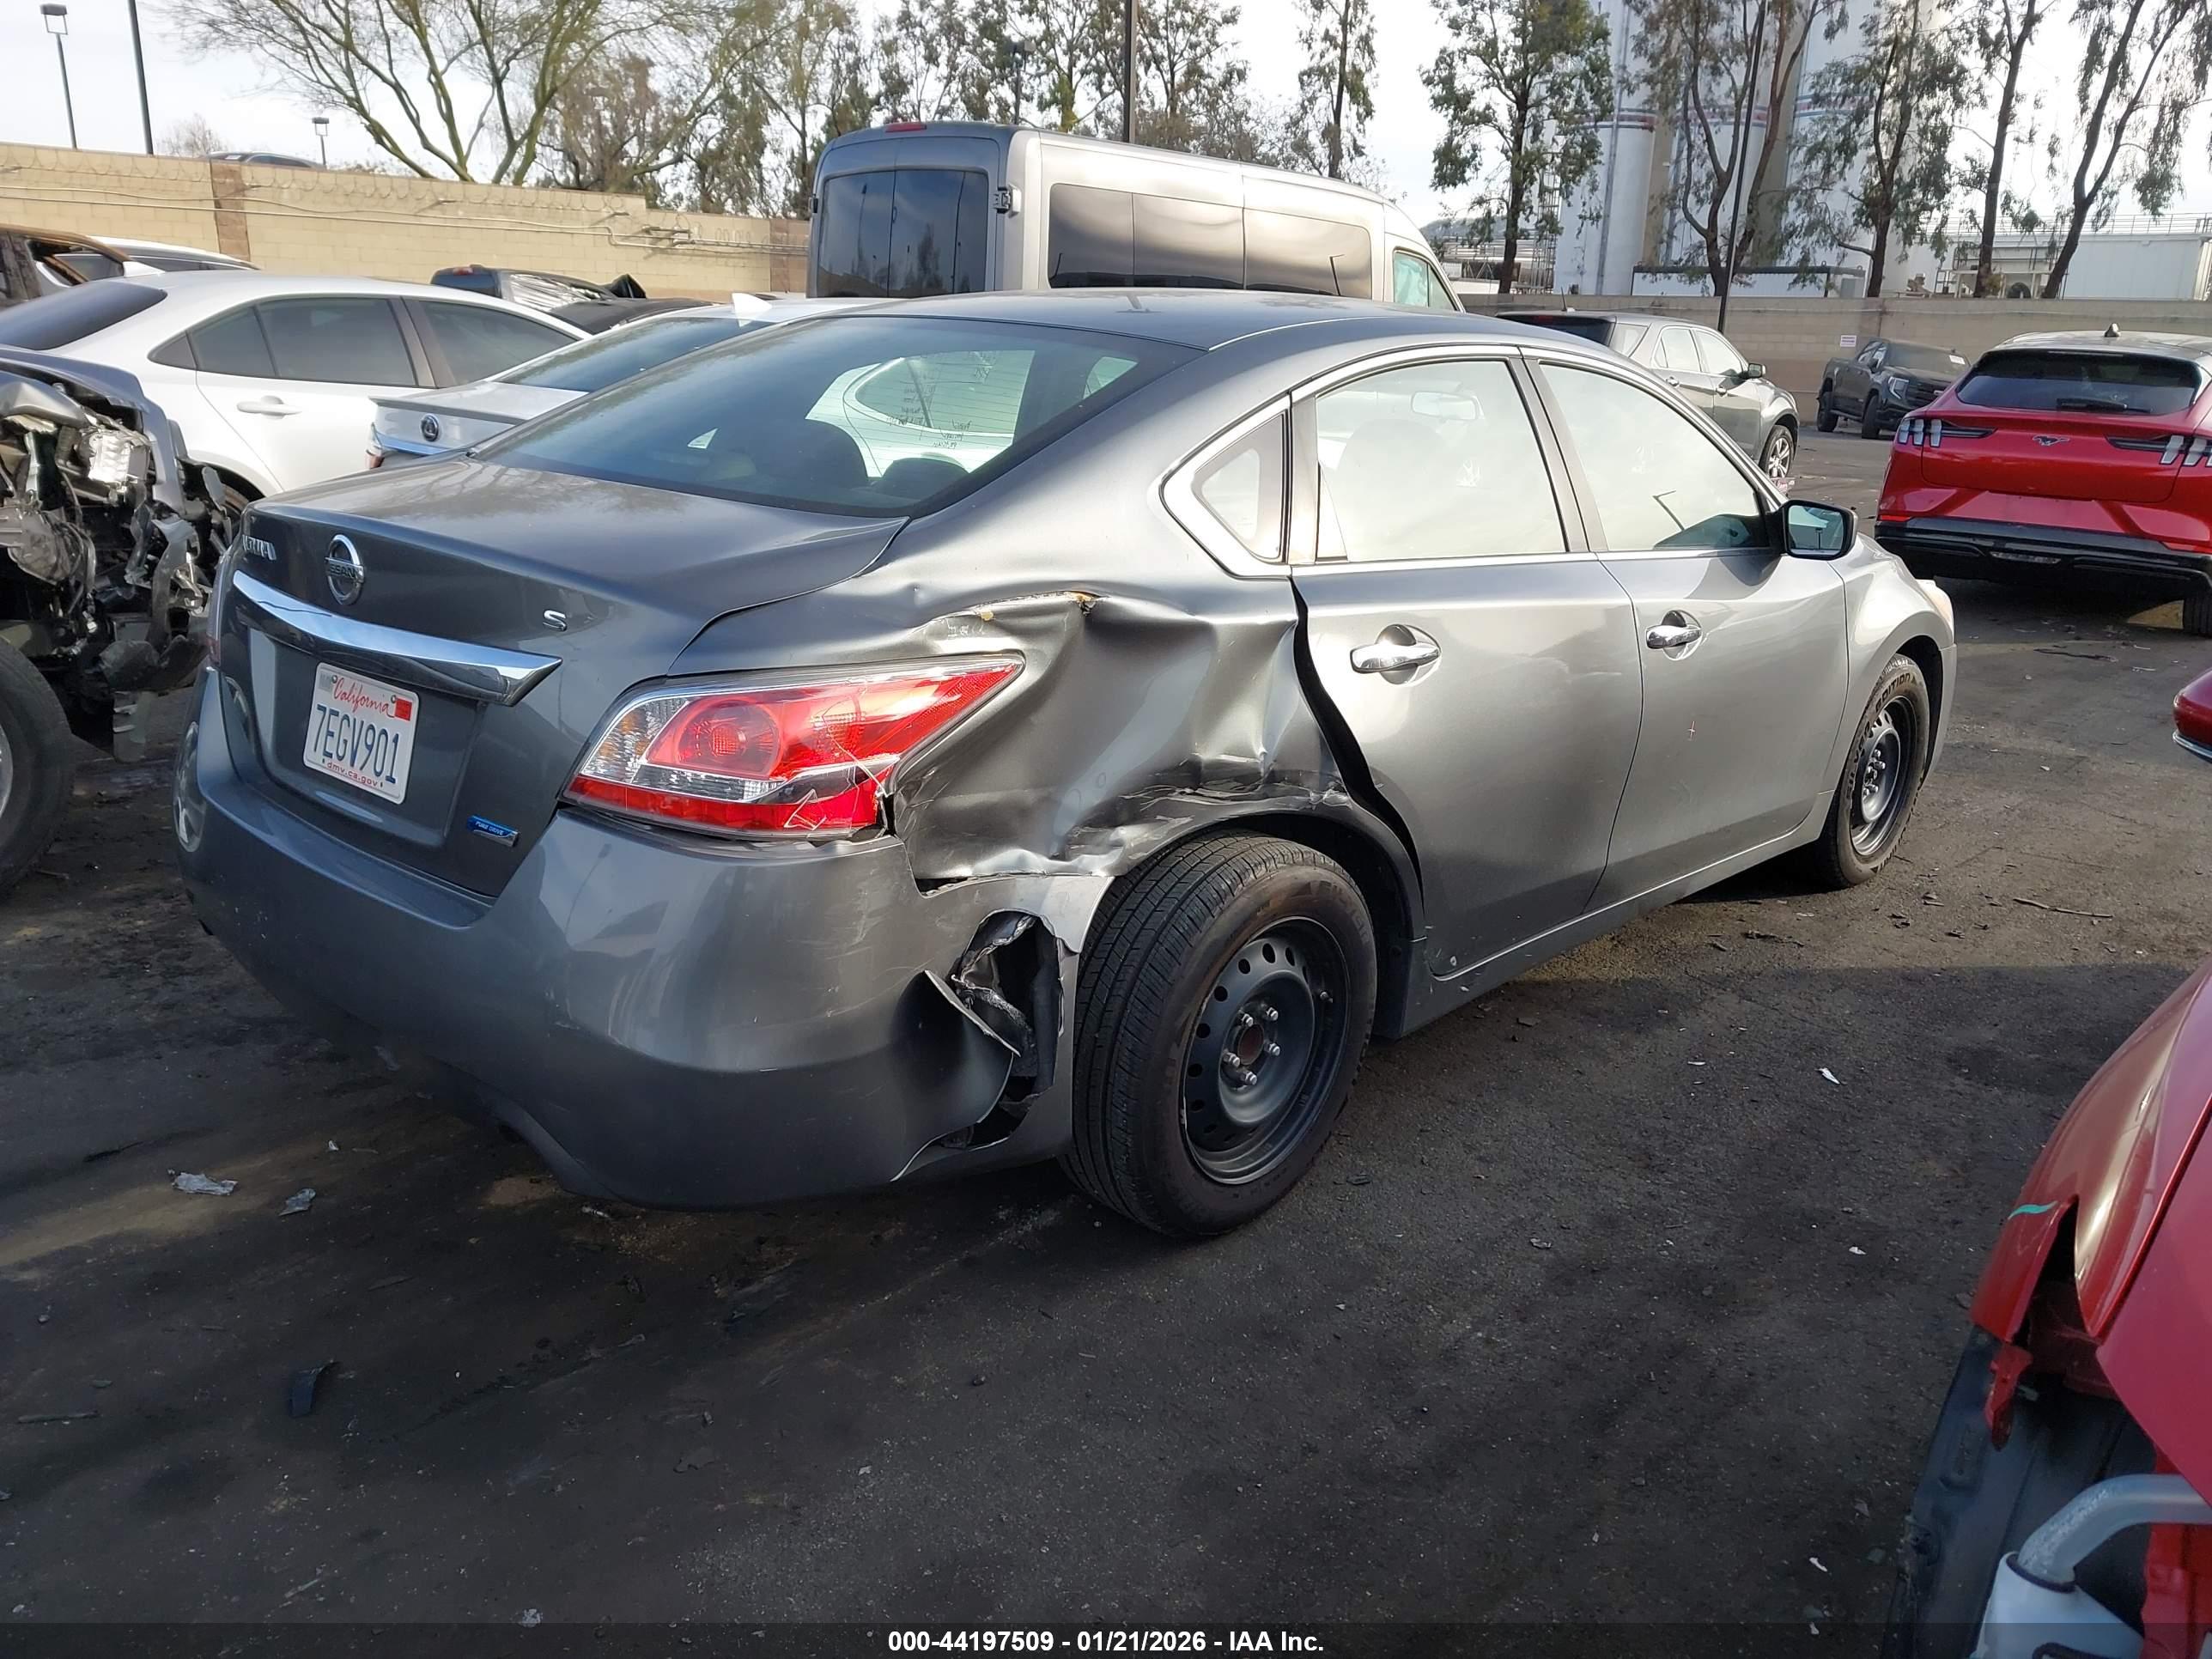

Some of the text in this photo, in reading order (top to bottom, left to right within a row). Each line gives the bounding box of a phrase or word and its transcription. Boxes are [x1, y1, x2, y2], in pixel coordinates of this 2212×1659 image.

[543, 609, 567, 631] S
[333, 677, 395, 718] California
[313, 703, 399, 784] 7EGV901
[326, 761, 378, 787] dmv.ca.gov
